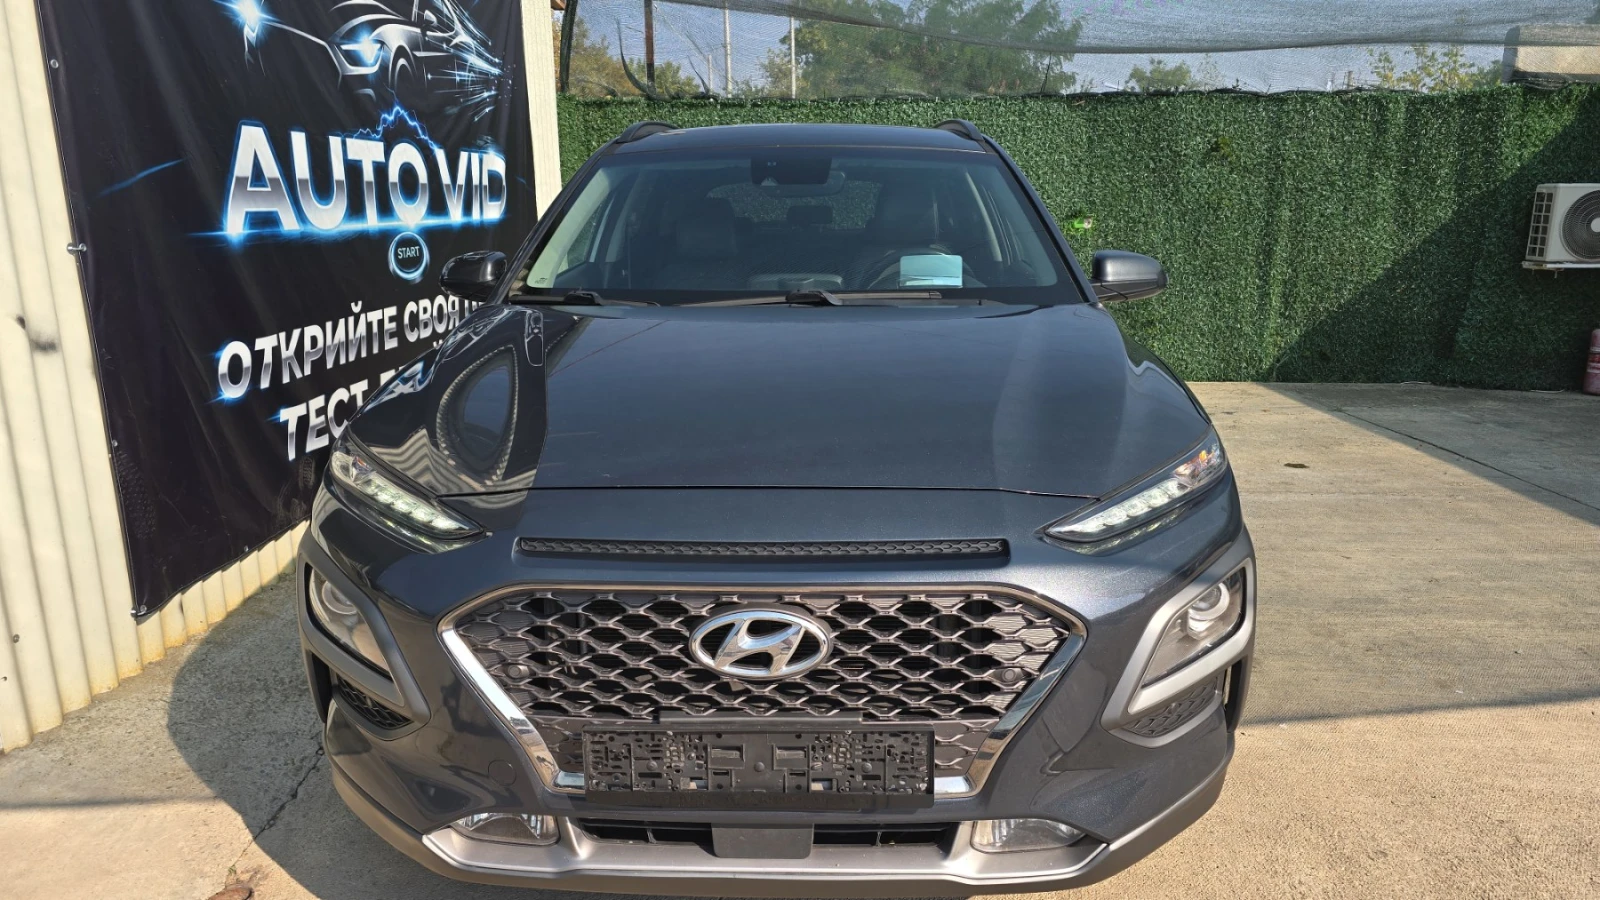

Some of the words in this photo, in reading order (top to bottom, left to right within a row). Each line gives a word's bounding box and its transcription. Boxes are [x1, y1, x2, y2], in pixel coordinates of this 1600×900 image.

[226, 125, 430, 234] AUTO
[435, 148, 507, 221] VID
[397, 246, 420, 259] START
[218, 300, 399, 399] ОТКРИЙТЕ
[403, 294, 460, 343] СВОЯ
[279, 379, 369, 462] ТЕСТ
